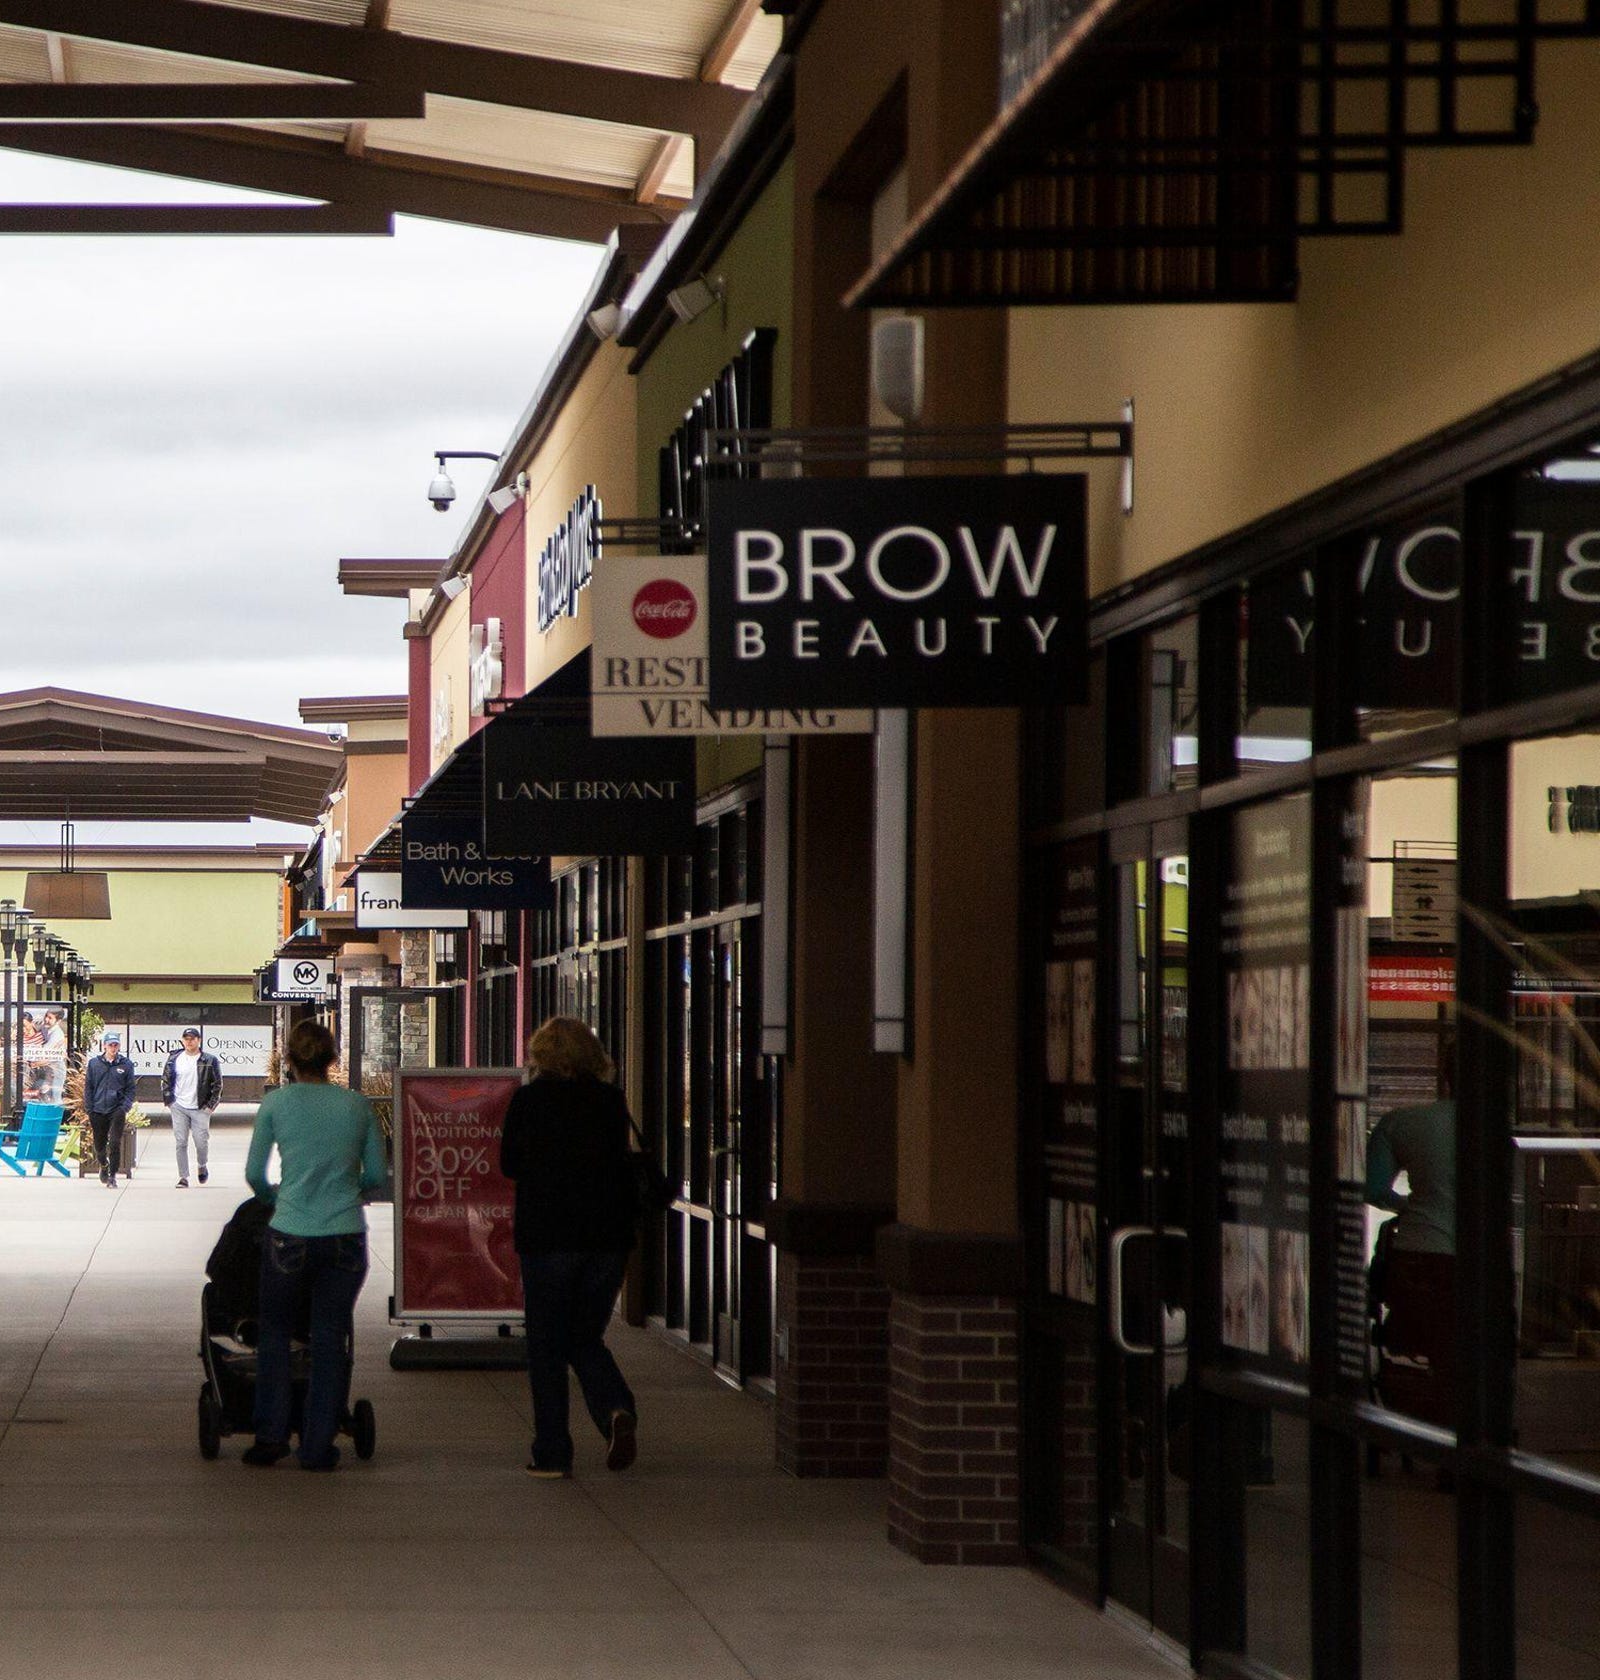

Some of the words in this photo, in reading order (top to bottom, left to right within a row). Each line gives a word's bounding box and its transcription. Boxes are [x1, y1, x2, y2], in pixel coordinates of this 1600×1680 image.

[736, 524, 1057, 602] BROW
[736, 616, 1059, 659] BEAUTY
[640, 700, 837, 729] VENDING
[497, 781, 569, 800] LANE
[575, 781, 683, 800] BRYANT
[407, 842, 460, 861] Bath
[464, 842, 481, 861] &
[440, 867, 514, 886] Works
[360, 891, 402, 910] fran
[296, 967, 316, 979] MK
[271, 991, 316, 999] CONVERSE
[131, 1039, 186, 1054] AUREN
[206, 1036, 264, 1050] OPENING
[219, 1052, 255, 1065] SOON
[415, 1112, 452, 1123] TAKE
[457, 1112, 481, 1122] AN
[414, 1126, 503, 1138] ADDITIONA
[416, 1146, 490, 1175] 30%
[415, 1177, 472, 1199] OFF
[414, 1205, 512, 1219] CLEARANCE
